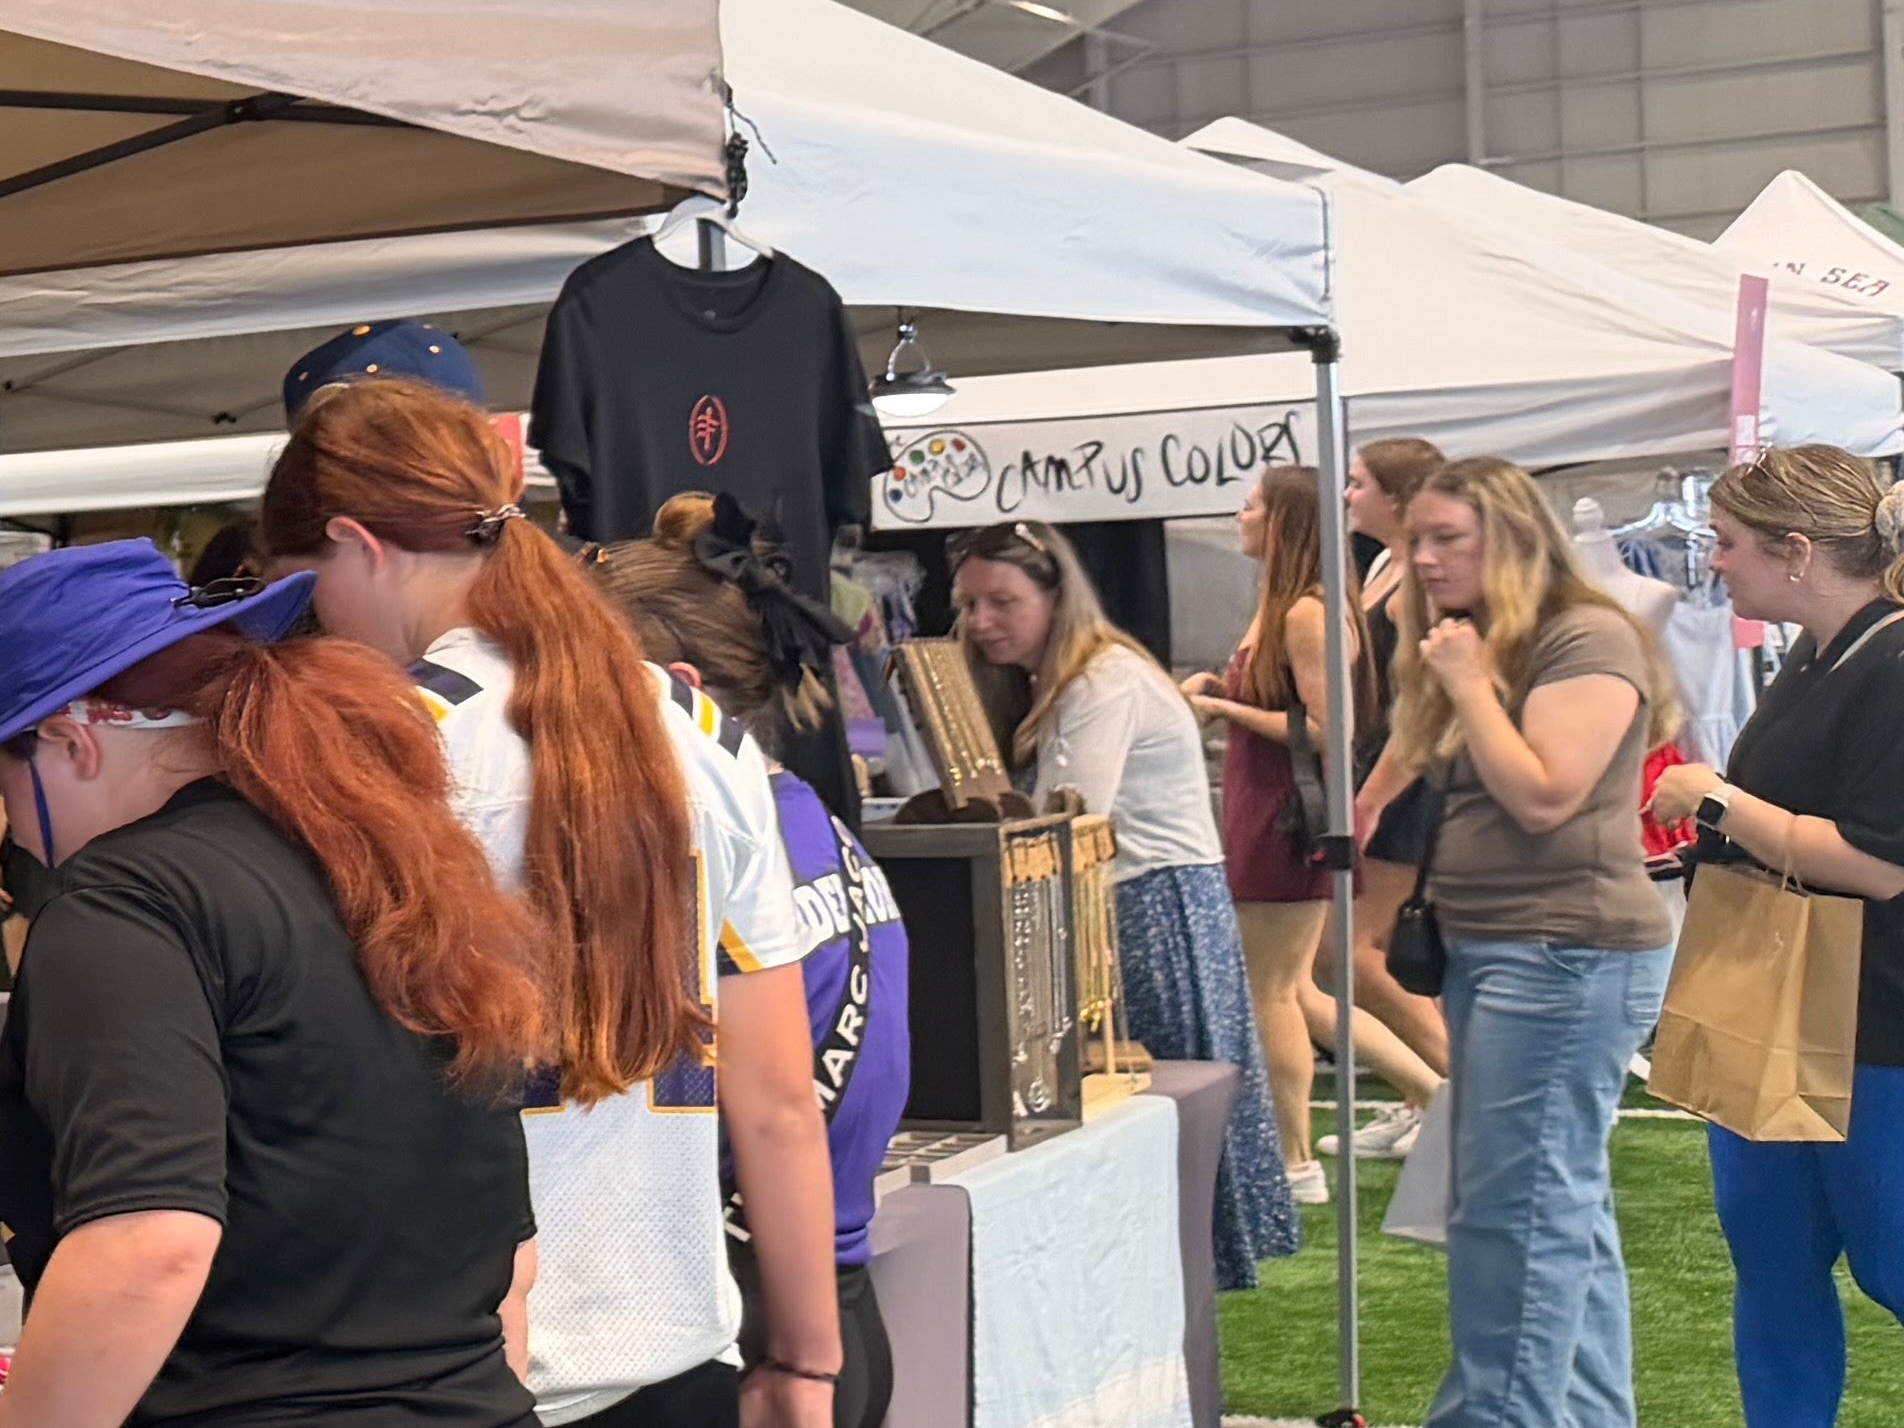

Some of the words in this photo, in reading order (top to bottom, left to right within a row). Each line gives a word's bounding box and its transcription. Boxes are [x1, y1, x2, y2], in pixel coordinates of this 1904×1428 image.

[1820, 266, 1890, 298] SEA
[996, 441, 1144, 514] CAMPUS
[1162, 410, 1302, 487] COLORS
